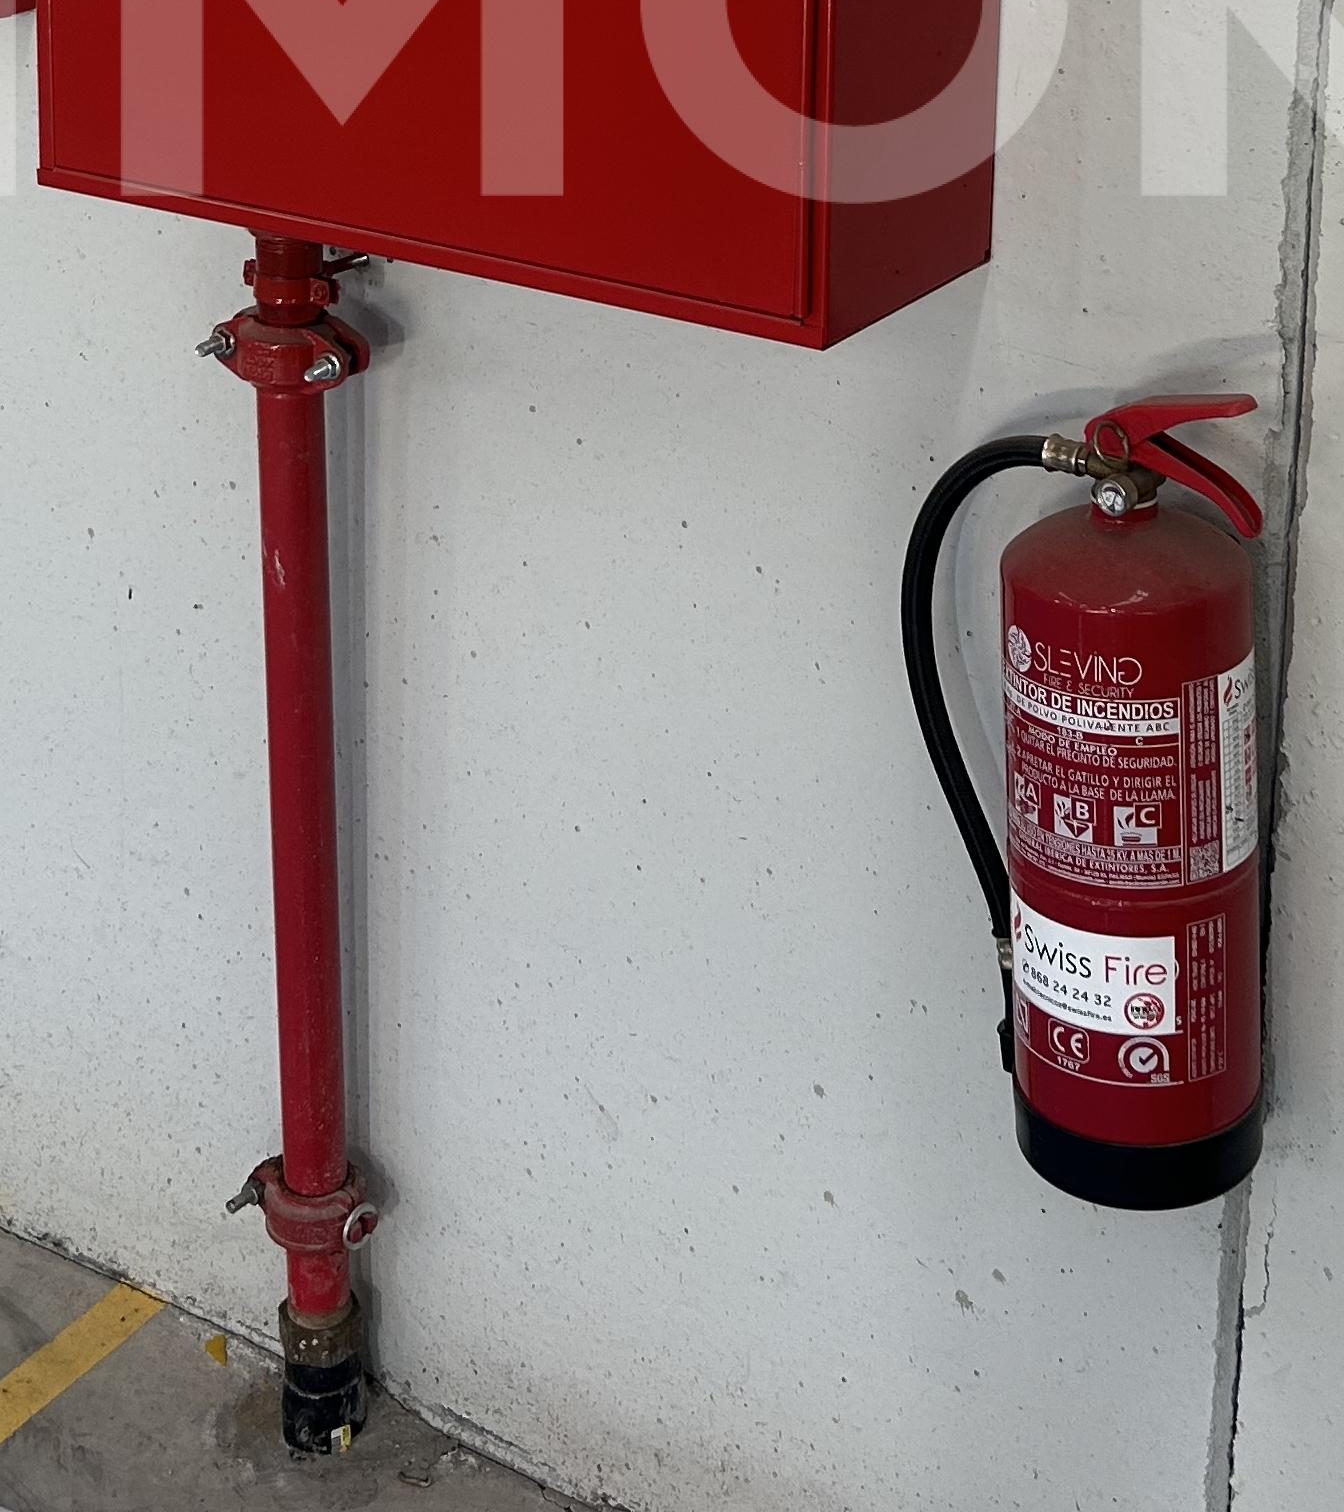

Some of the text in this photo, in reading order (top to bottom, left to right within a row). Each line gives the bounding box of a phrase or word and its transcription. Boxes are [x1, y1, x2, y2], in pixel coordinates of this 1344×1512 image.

[1078, 682, 1135, 699] SECURITY
[1027, 701, 1058, 721] POLVO
[1061, 715, 1140, 733] POLIVALENTE
[1146, 721, 1170, 733] ABC
[1051, 691, 1073, 713] DE
[1076, 699, 1175, 721] INCENDIOS
[1028, 725, 1118, 756] MODO DE EMPLEO
[1135, 736, 1144, 746] C
[1046, 742, 1056, 756] EL
[1102, 755, 1116, 768] DE
[1056, 764, 1066, 778] EL
[1068, 768, 1109, 787] GATILLO
[1112, 775, 1120, 788] Y
[1123, 775, 1163, 789] DIRIGIR
[1165, 774, 1177, 787] EL
[1026, 782, 1038, 804] A
[1068, 781, 1080, 795] LA
[1081, 784, 1105, 800] BASE
[1109, 788, 1124, 802] DE
[1125, 789, 1139, 802] LA
[1075, 801, 1090, 820] B
[1139, 807, 1156, 825] C
[1024, 923, 1168, 986] Swiss Fire
[1053, 979, 1068, 996] 24
[1072, 987, 1089, 1003] 24
[1093, 993, 1113, 1008] 32
[1053, 1026, 1084, 1059] CE
